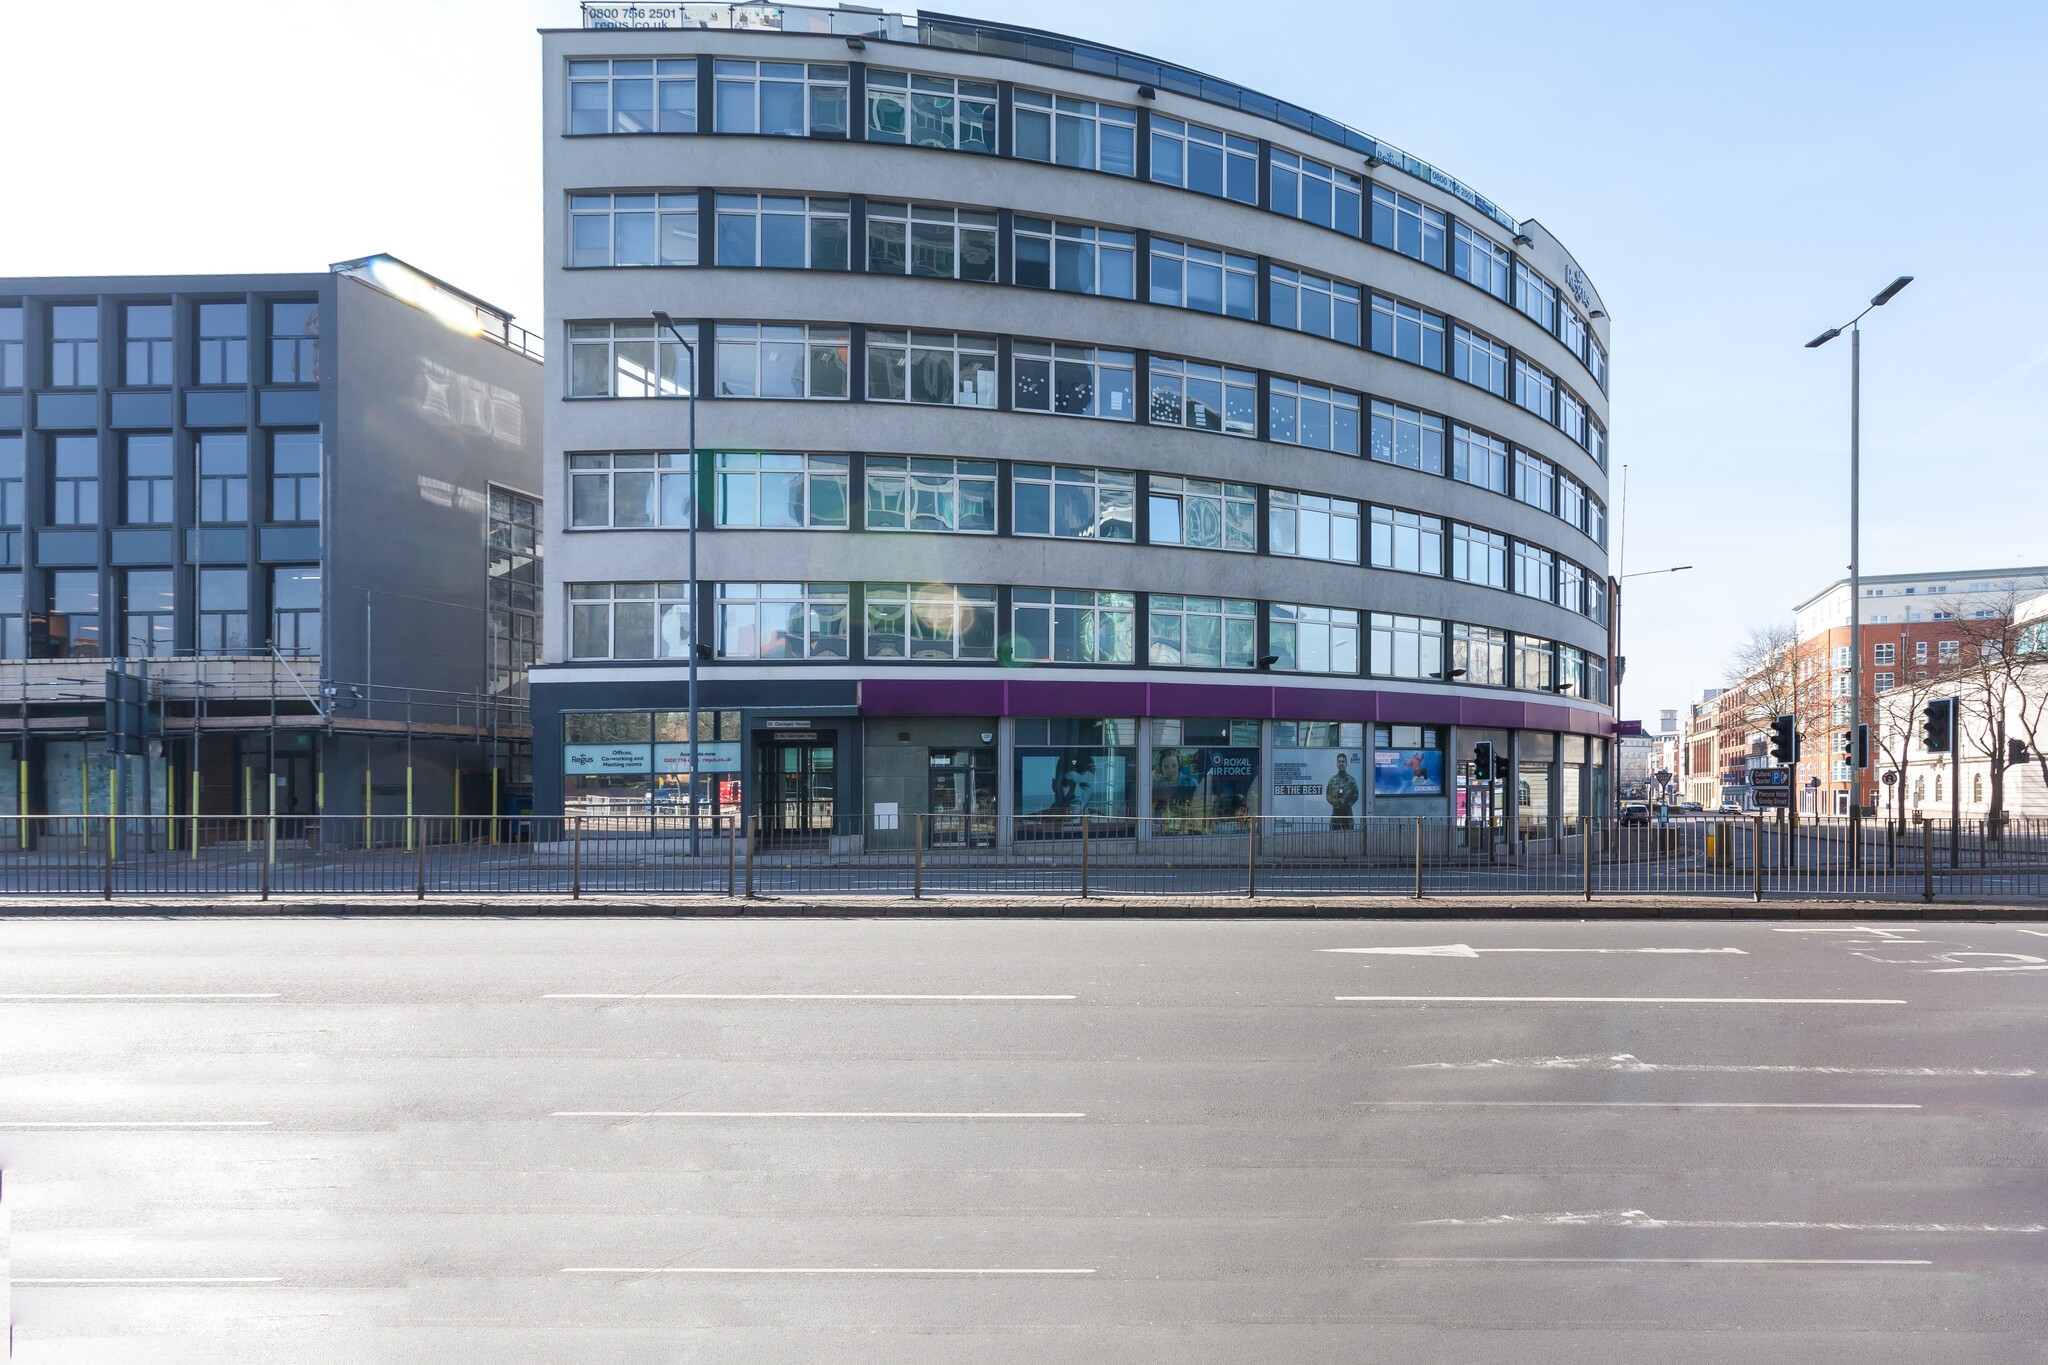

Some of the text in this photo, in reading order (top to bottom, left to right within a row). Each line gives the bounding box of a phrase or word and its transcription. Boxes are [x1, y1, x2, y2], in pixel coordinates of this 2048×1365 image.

[589, 8, 677, 19] 0800 756 2501
[594, 20, 668, 28] reguscouk
[1432, 171, 1447, 185] 0800
[1565, 265, 1590, 308] Regus
[571, 755, 594, 765] Regus
[1223, 757, 1251, 766] ROYAL
[1206, 767, 1252, 776] AIR FORCE
[1773, 772, 1779, 783] P
[1274, 785, 1322, 795] BE THE BEST
